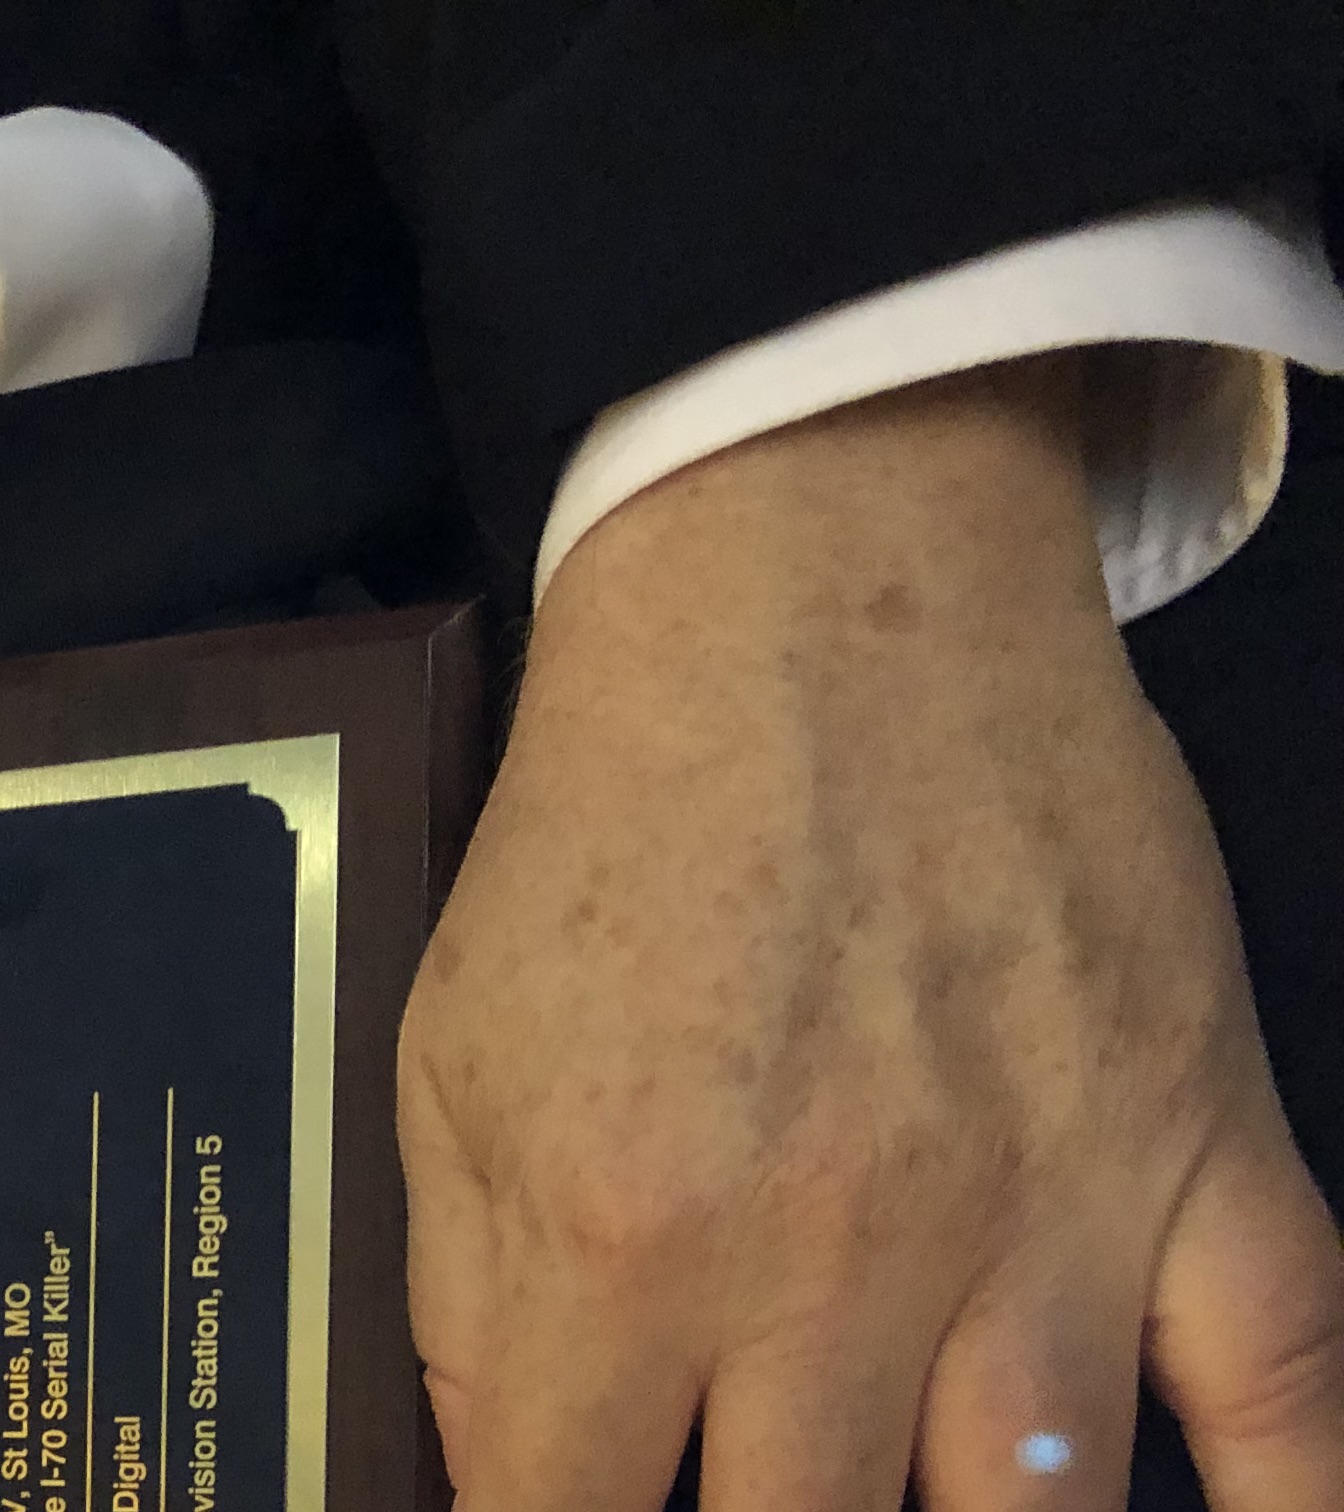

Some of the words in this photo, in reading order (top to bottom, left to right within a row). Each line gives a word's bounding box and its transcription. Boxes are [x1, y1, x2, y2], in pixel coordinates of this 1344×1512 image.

[196, 1134, 223, 1156] 5
[192, 1164, 228, 1278] Region
[4, 1282, 32, 1337] MO
[41, 1332, 69, 1421] Serial
[189, 1288, 224, 1410] Station,
[3, 1347, 34, 1439] Louis,
[1, 1447, 29, 1481] St
[40, 1428, 68, 1487] I-70
